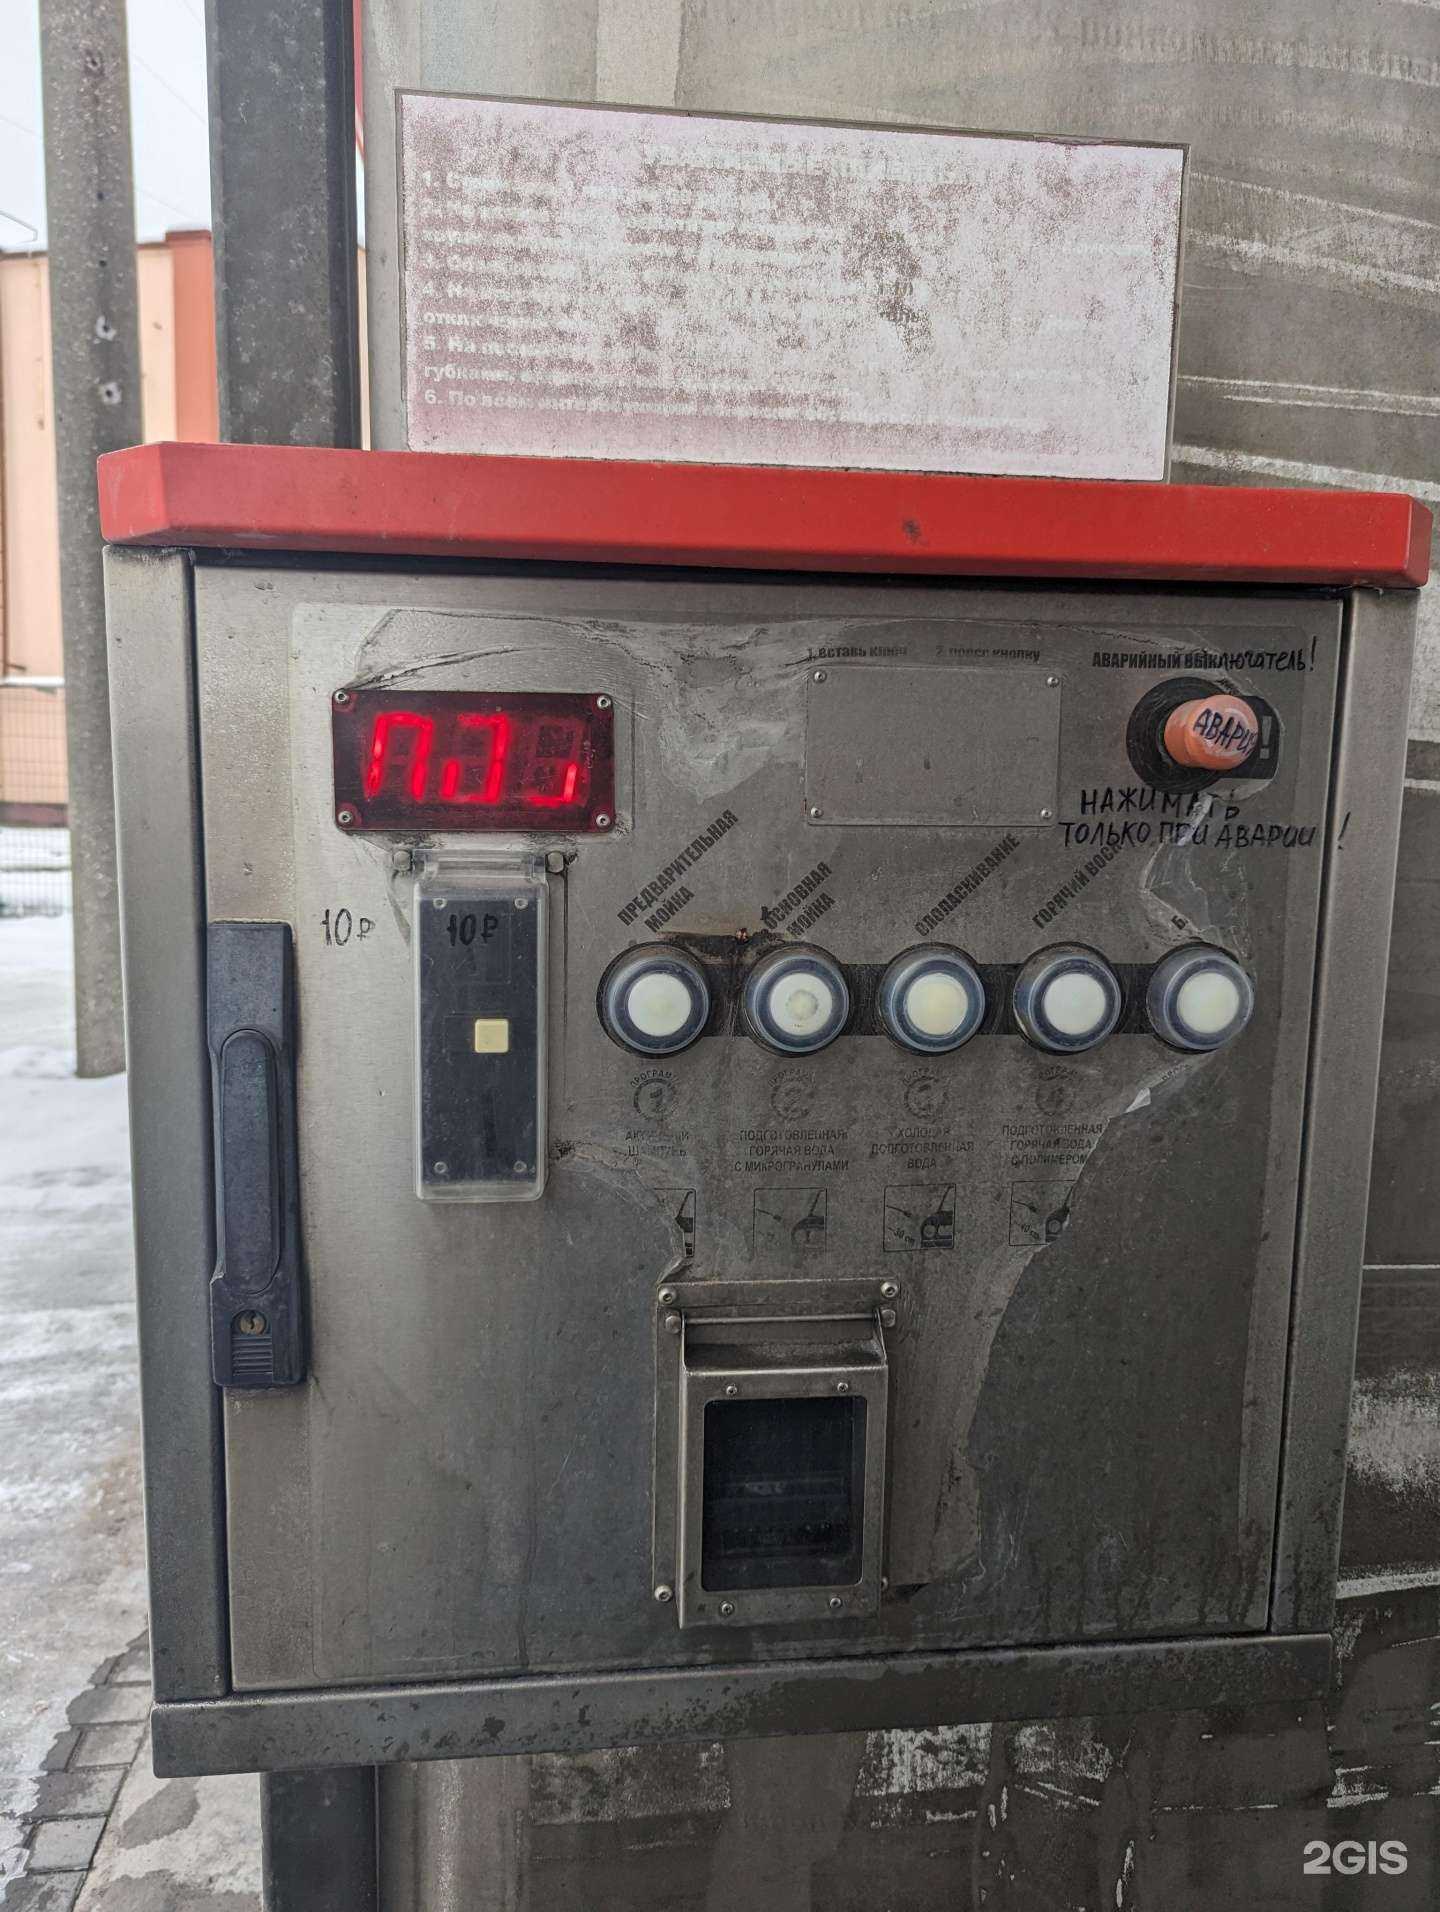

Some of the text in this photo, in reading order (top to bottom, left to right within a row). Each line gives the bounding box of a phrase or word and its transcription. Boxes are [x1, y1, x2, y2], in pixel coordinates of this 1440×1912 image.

[1092, 650, 1181, 669] АВАРИЙНЫЙ
[1058, 821, 1150, 848] ТОЛЬКО
[617, 808, 739, 927] ПРЕДВАРИТЕЛЬНАЯ
[914, 833, 1021, 937] ОПОЛАСКИВАНИЕ
[644, 885, 695, 933] МОЙКА
[763, 860, 834, 930] ОСНОВНАЯ
[786, 892, 837, 938] МОЙКА
[1032, 868, 1090, 930] ГОРЯЧИЙ
[749, 1144, 802, 1157] ГОРЯЧАЯ
